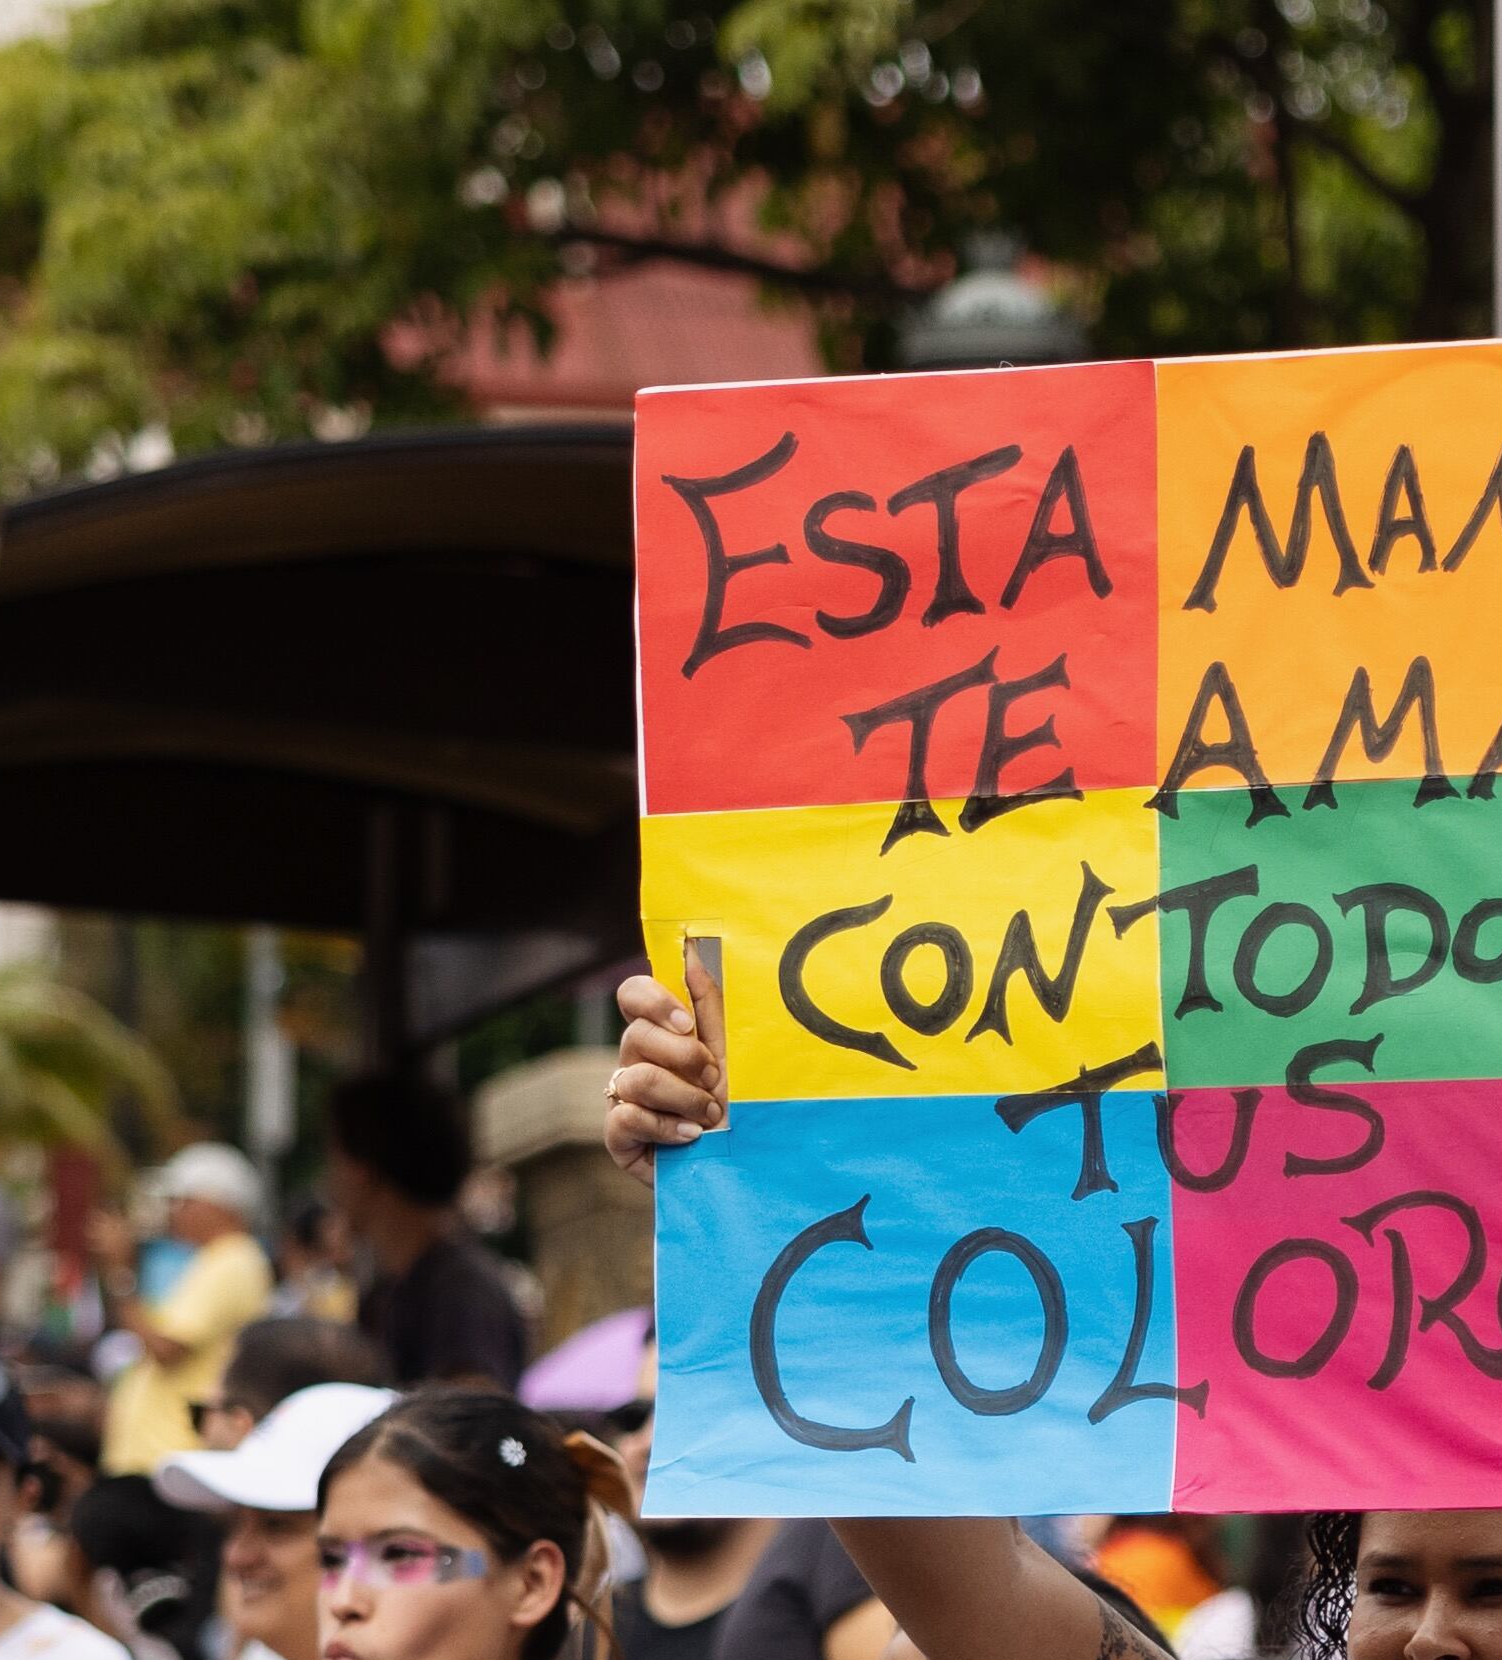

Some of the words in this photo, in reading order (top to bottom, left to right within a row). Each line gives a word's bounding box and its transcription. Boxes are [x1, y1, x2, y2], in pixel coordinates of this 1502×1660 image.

[661, 432, 1113, 680] ESTA
[842, 647, 1083, 855] TE
[777, 859, 1115, 1070] CON
[995, 1032, 1385, 1201] TUS
